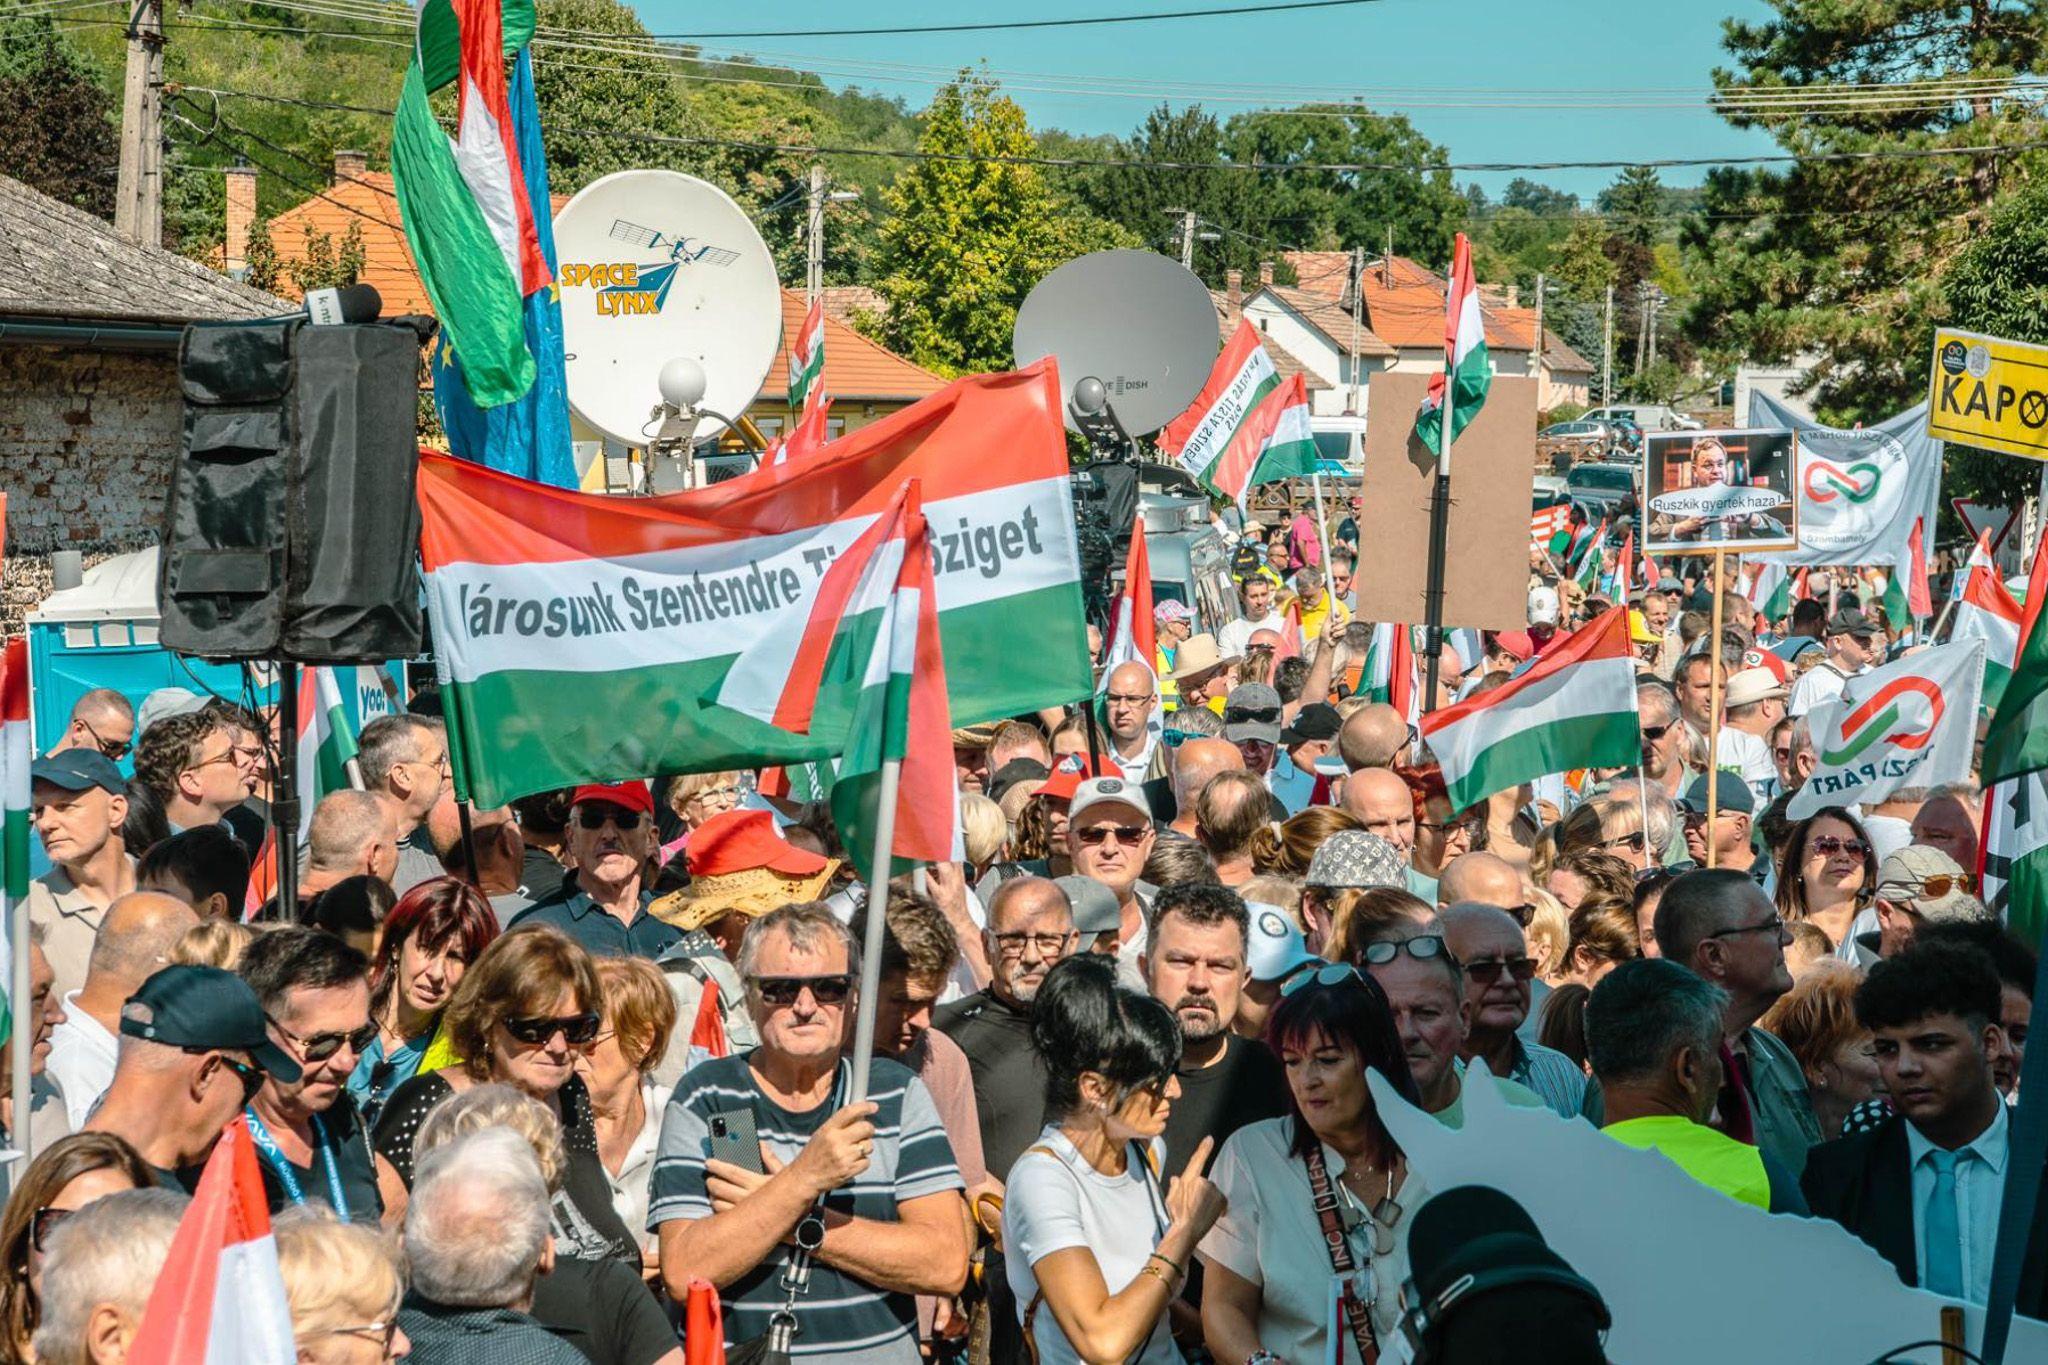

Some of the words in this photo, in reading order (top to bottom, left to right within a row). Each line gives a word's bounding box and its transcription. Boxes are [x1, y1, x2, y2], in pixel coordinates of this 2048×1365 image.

[561, 264, 638, 288] SPACE
[596, 292, 659, 317] LYNX
[1125, 381, 1149, 390] DISH
[1653, 498, 1699, 511] Ruszkik
[1702, 497, 1745, 512] gyertek
[622, 560, 802, 631] Szentendre
